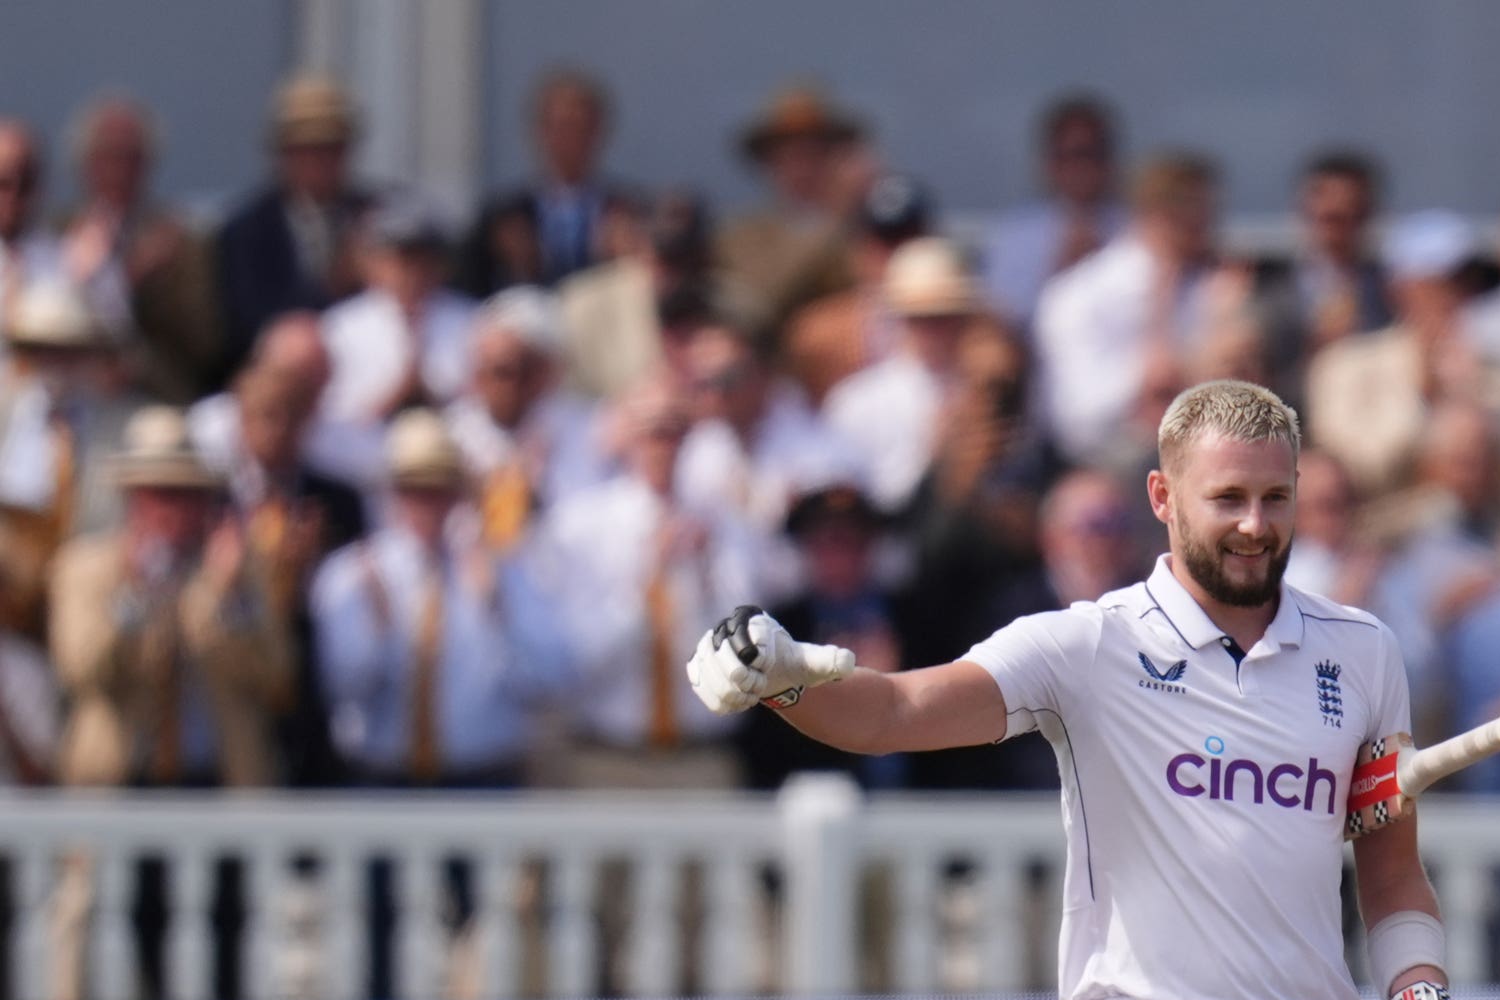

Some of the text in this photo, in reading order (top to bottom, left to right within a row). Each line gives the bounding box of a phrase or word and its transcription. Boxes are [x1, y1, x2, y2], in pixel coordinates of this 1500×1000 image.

[1138, 679, 1187, 694] CASTORE
[1322, 715, 1342, 728] 714
[1166, 735, 1337, 815] cinch
